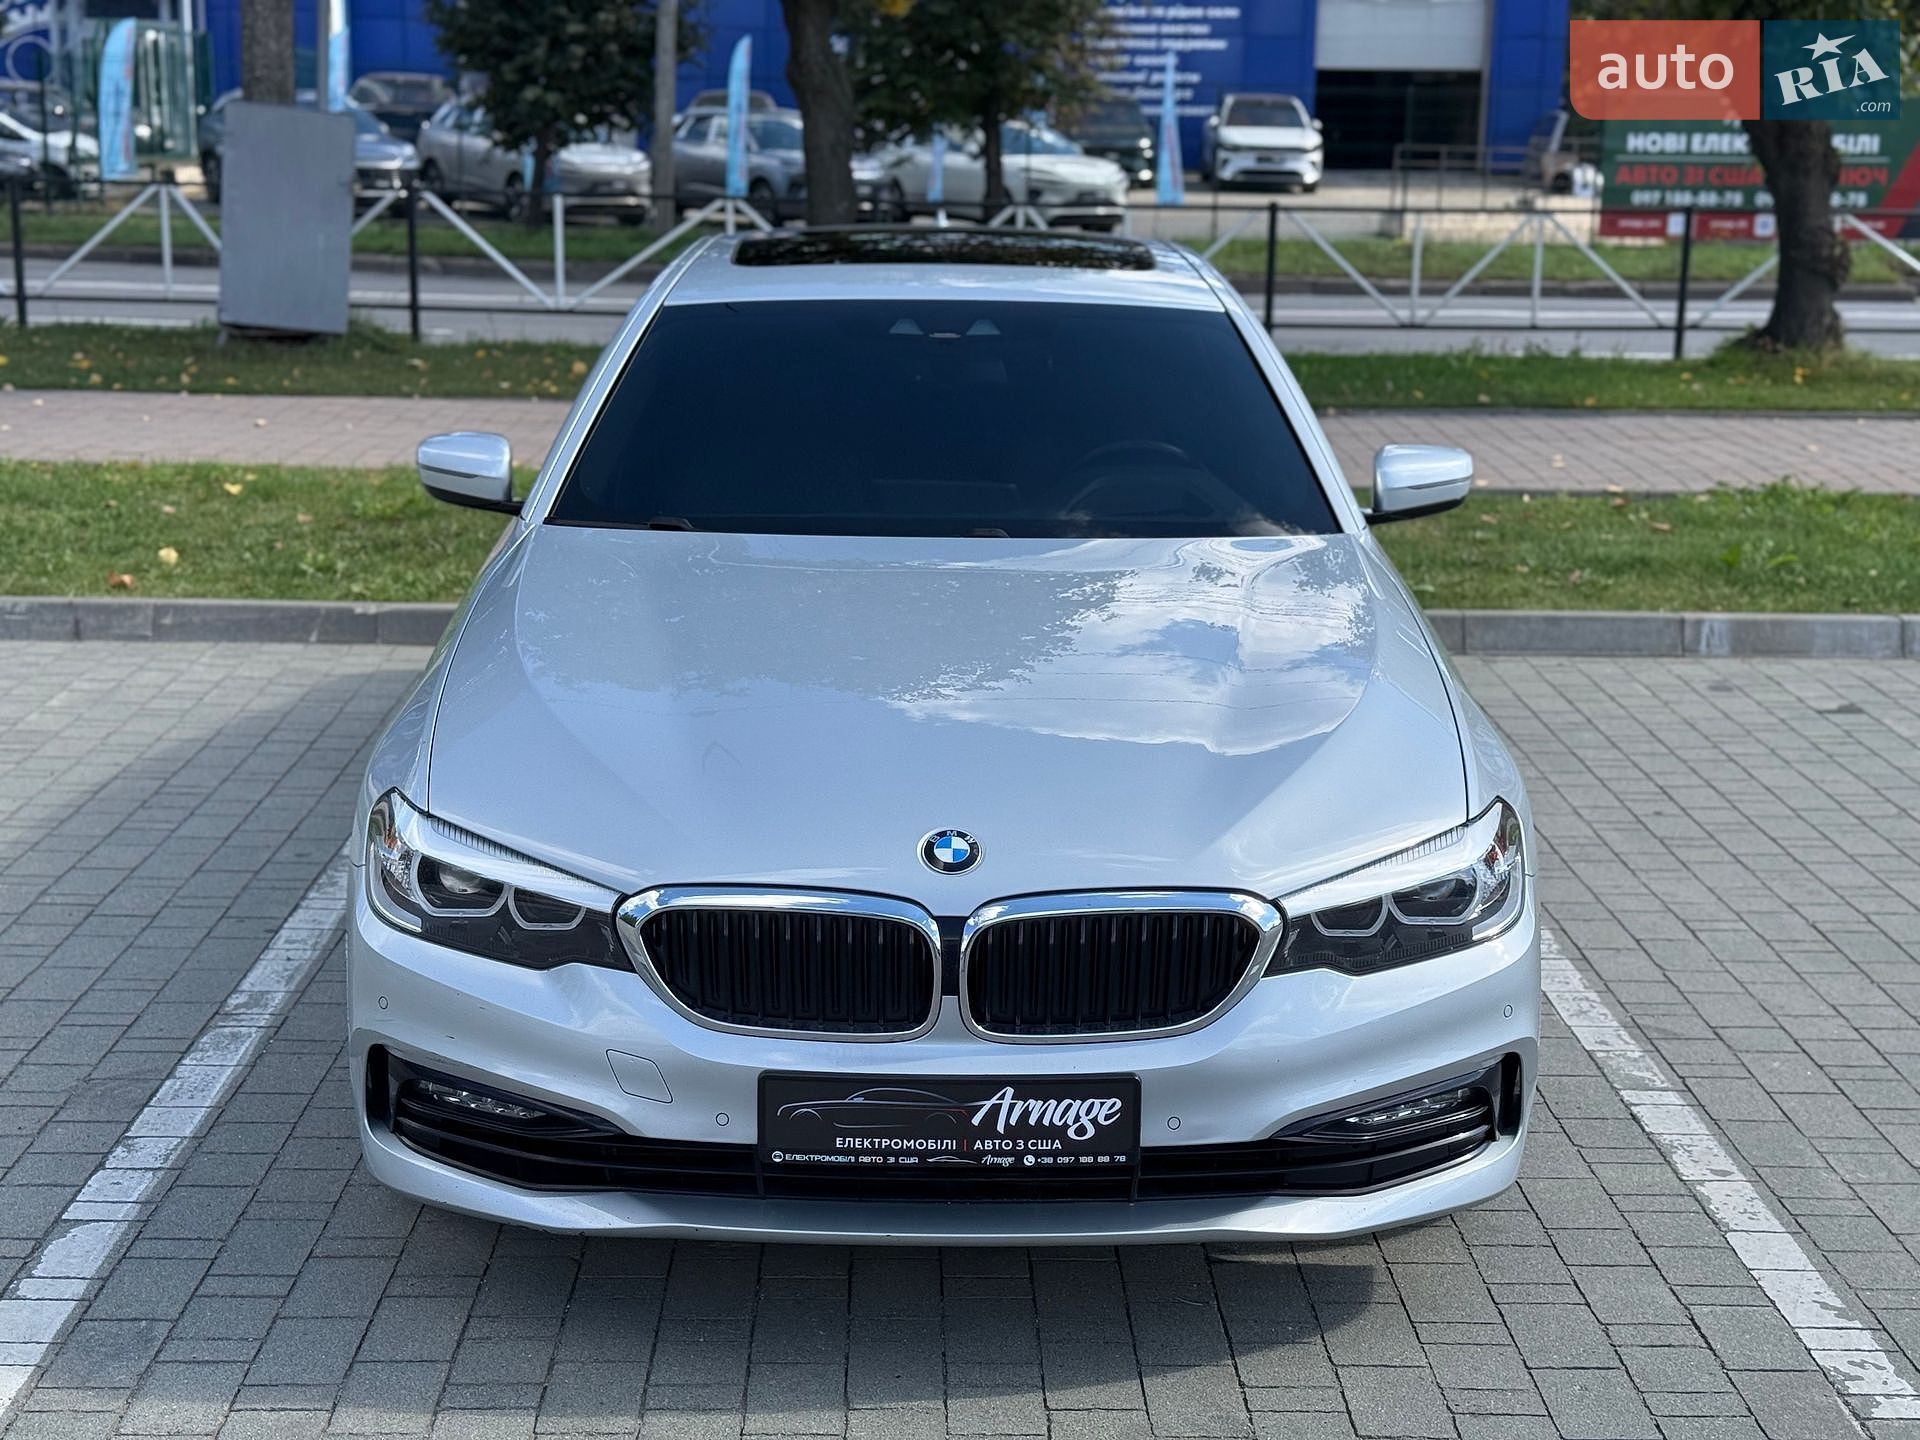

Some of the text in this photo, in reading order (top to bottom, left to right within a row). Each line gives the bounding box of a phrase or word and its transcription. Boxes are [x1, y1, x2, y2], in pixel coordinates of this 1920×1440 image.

[1627, 133, 1687, 154] НОВІ
[929, 830, 976, 844] BMW
[971, 1086, 1122, 1141] Arnage
[835, 1137, 957, 1151] ЕЛЕКТРОМОБІЛІ
[973, 1139, 1013, 1150] АВТО
[1027, 1139, 1062, 1150] США
[785, 1153, 856, 1163] ЕЛЕКТРОМОБІЛІ
[858, 1155, 884, 1164] АВТО
[898, 1156, 919, 1164] США
[981, 1154, 1015, 1167] Arnage
[1057, 1156, 1075, 1164] 097
